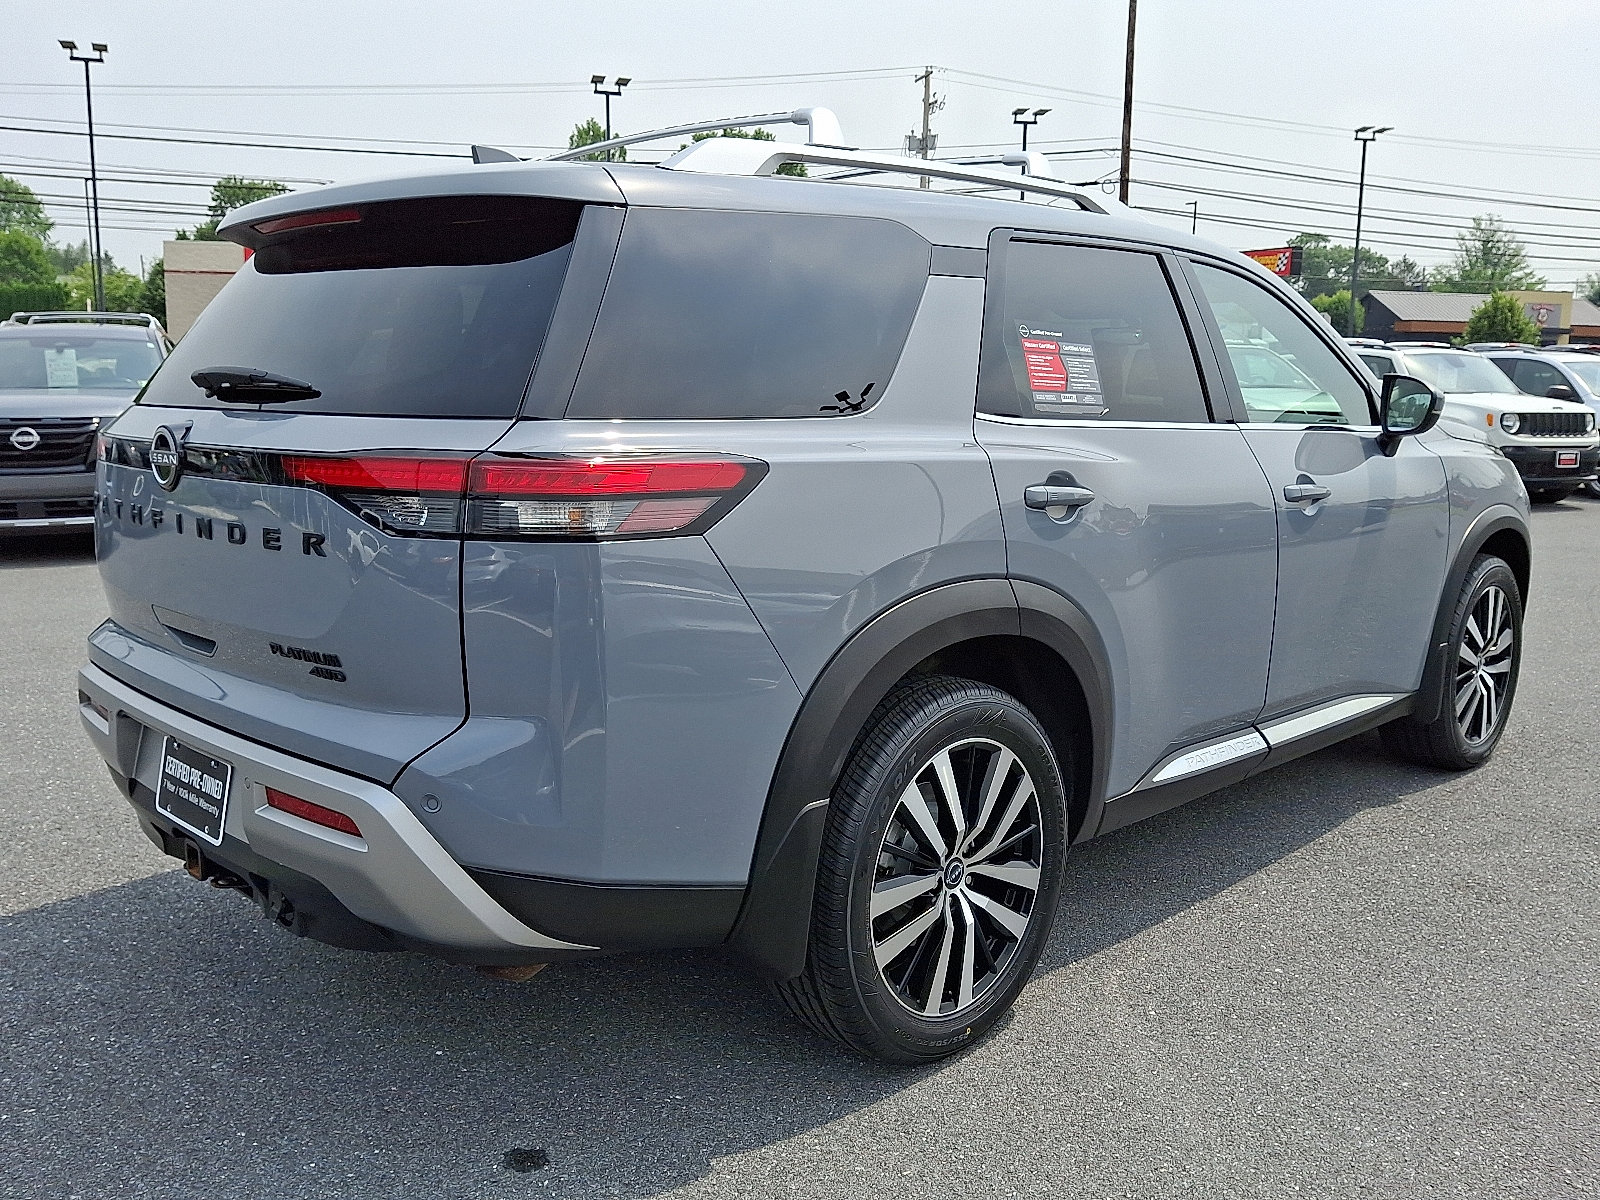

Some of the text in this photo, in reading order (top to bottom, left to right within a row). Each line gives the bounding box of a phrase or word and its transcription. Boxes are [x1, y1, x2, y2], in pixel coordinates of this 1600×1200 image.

[269, 641, 343, 668] PLATINUM
[308, 665, 347, 683] 4WD
[1185, 736, 1262, 768] PATHFINDER
[164, 755, 223, 800] CERTIFIED PRE-OWNED
[198, 796, 220, 819] Warranty
